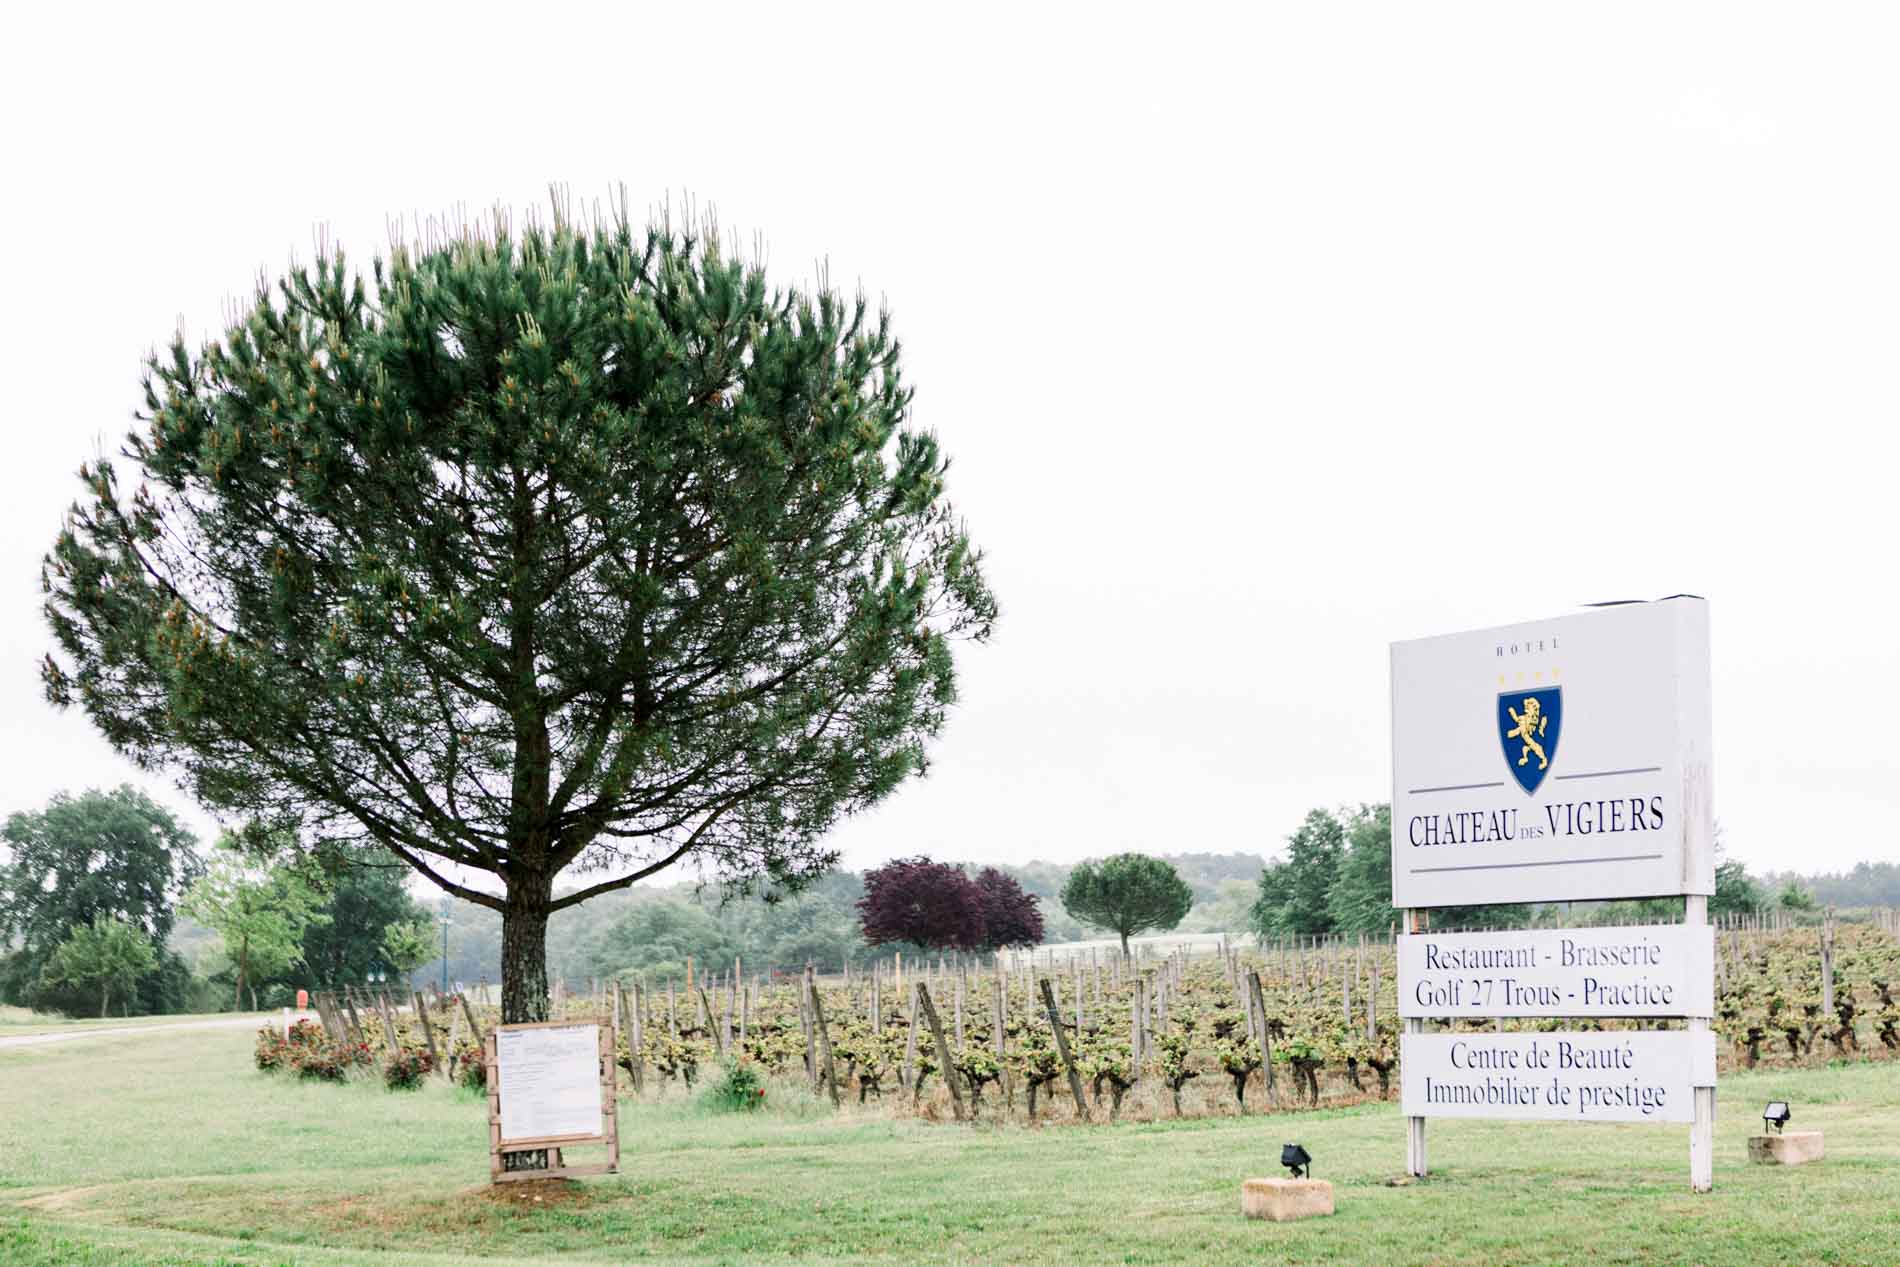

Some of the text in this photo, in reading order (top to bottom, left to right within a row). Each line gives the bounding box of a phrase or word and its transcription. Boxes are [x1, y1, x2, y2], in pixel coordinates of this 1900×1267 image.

[1409, 796, 1664, 848] CHATEAU DES VIGIERS
[1425, 943, 1536, 970] Restaurant
[1561, 937, 1661, 967] Brasserie
[1416, 979, 1463, 1007] Golf
[1471, 979, 1493, 1006] 27
[1500, 979, 1560, 1006] Trous
[1584, 976, 1673, 1005] Practice
[1451, 1040, 1633, 1069] Centre de Beauté
[1425, 1077, 1665, 1115] Immobilier de prestige
